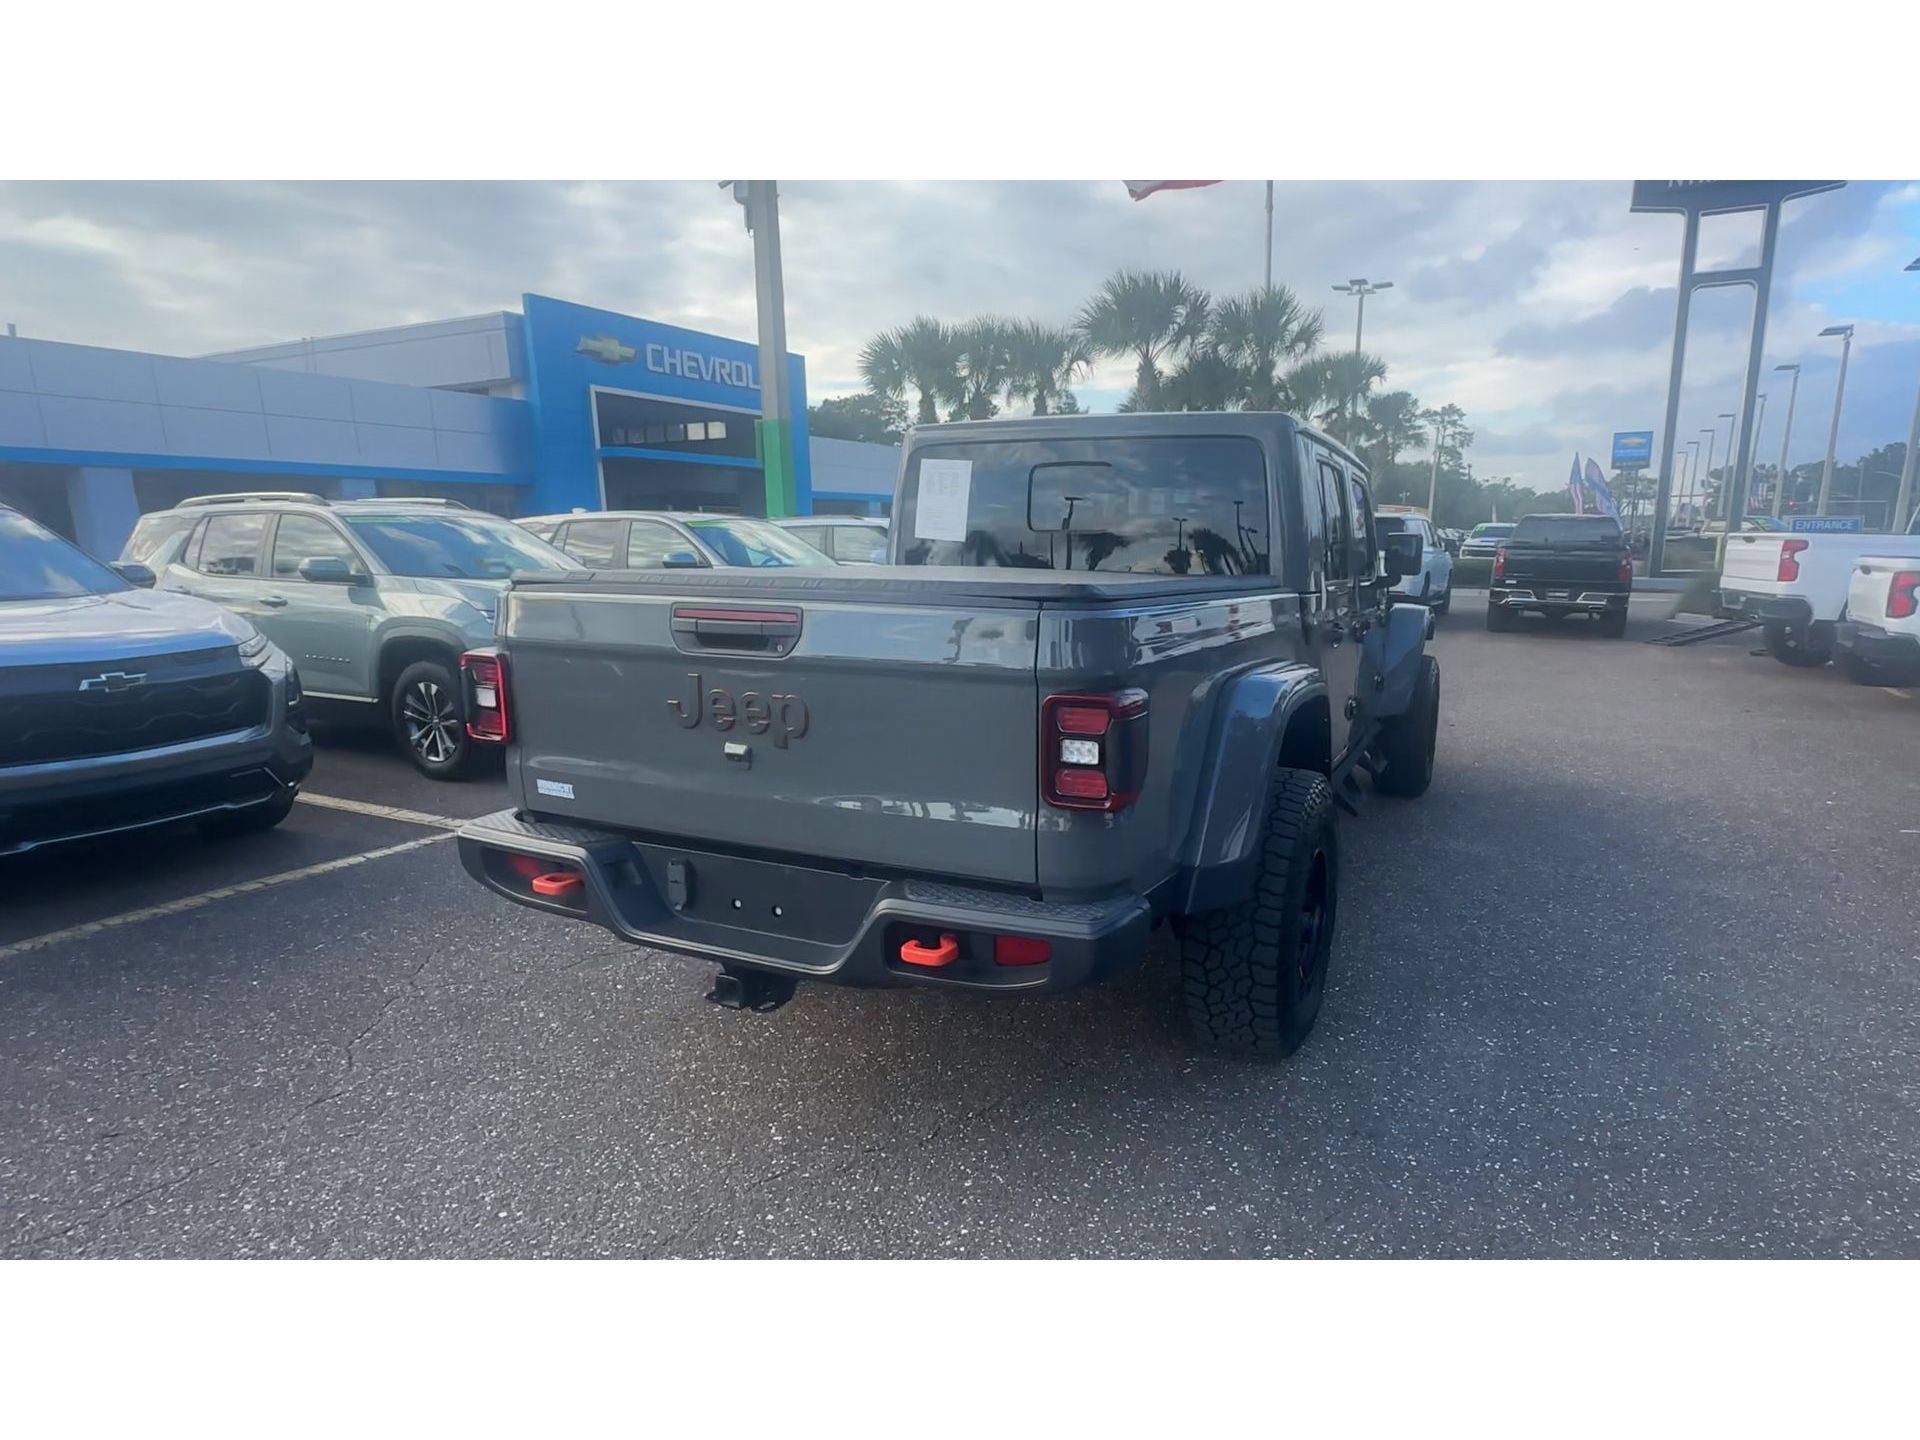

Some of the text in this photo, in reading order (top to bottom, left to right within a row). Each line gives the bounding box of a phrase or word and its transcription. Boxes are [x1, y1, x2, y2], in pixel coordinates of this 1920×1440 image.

[646, 343, 761, 390] CHEVROL
[1795, 520, 1855, 530] ENTRANCE
[667, 673, 809, 749] Jeep
